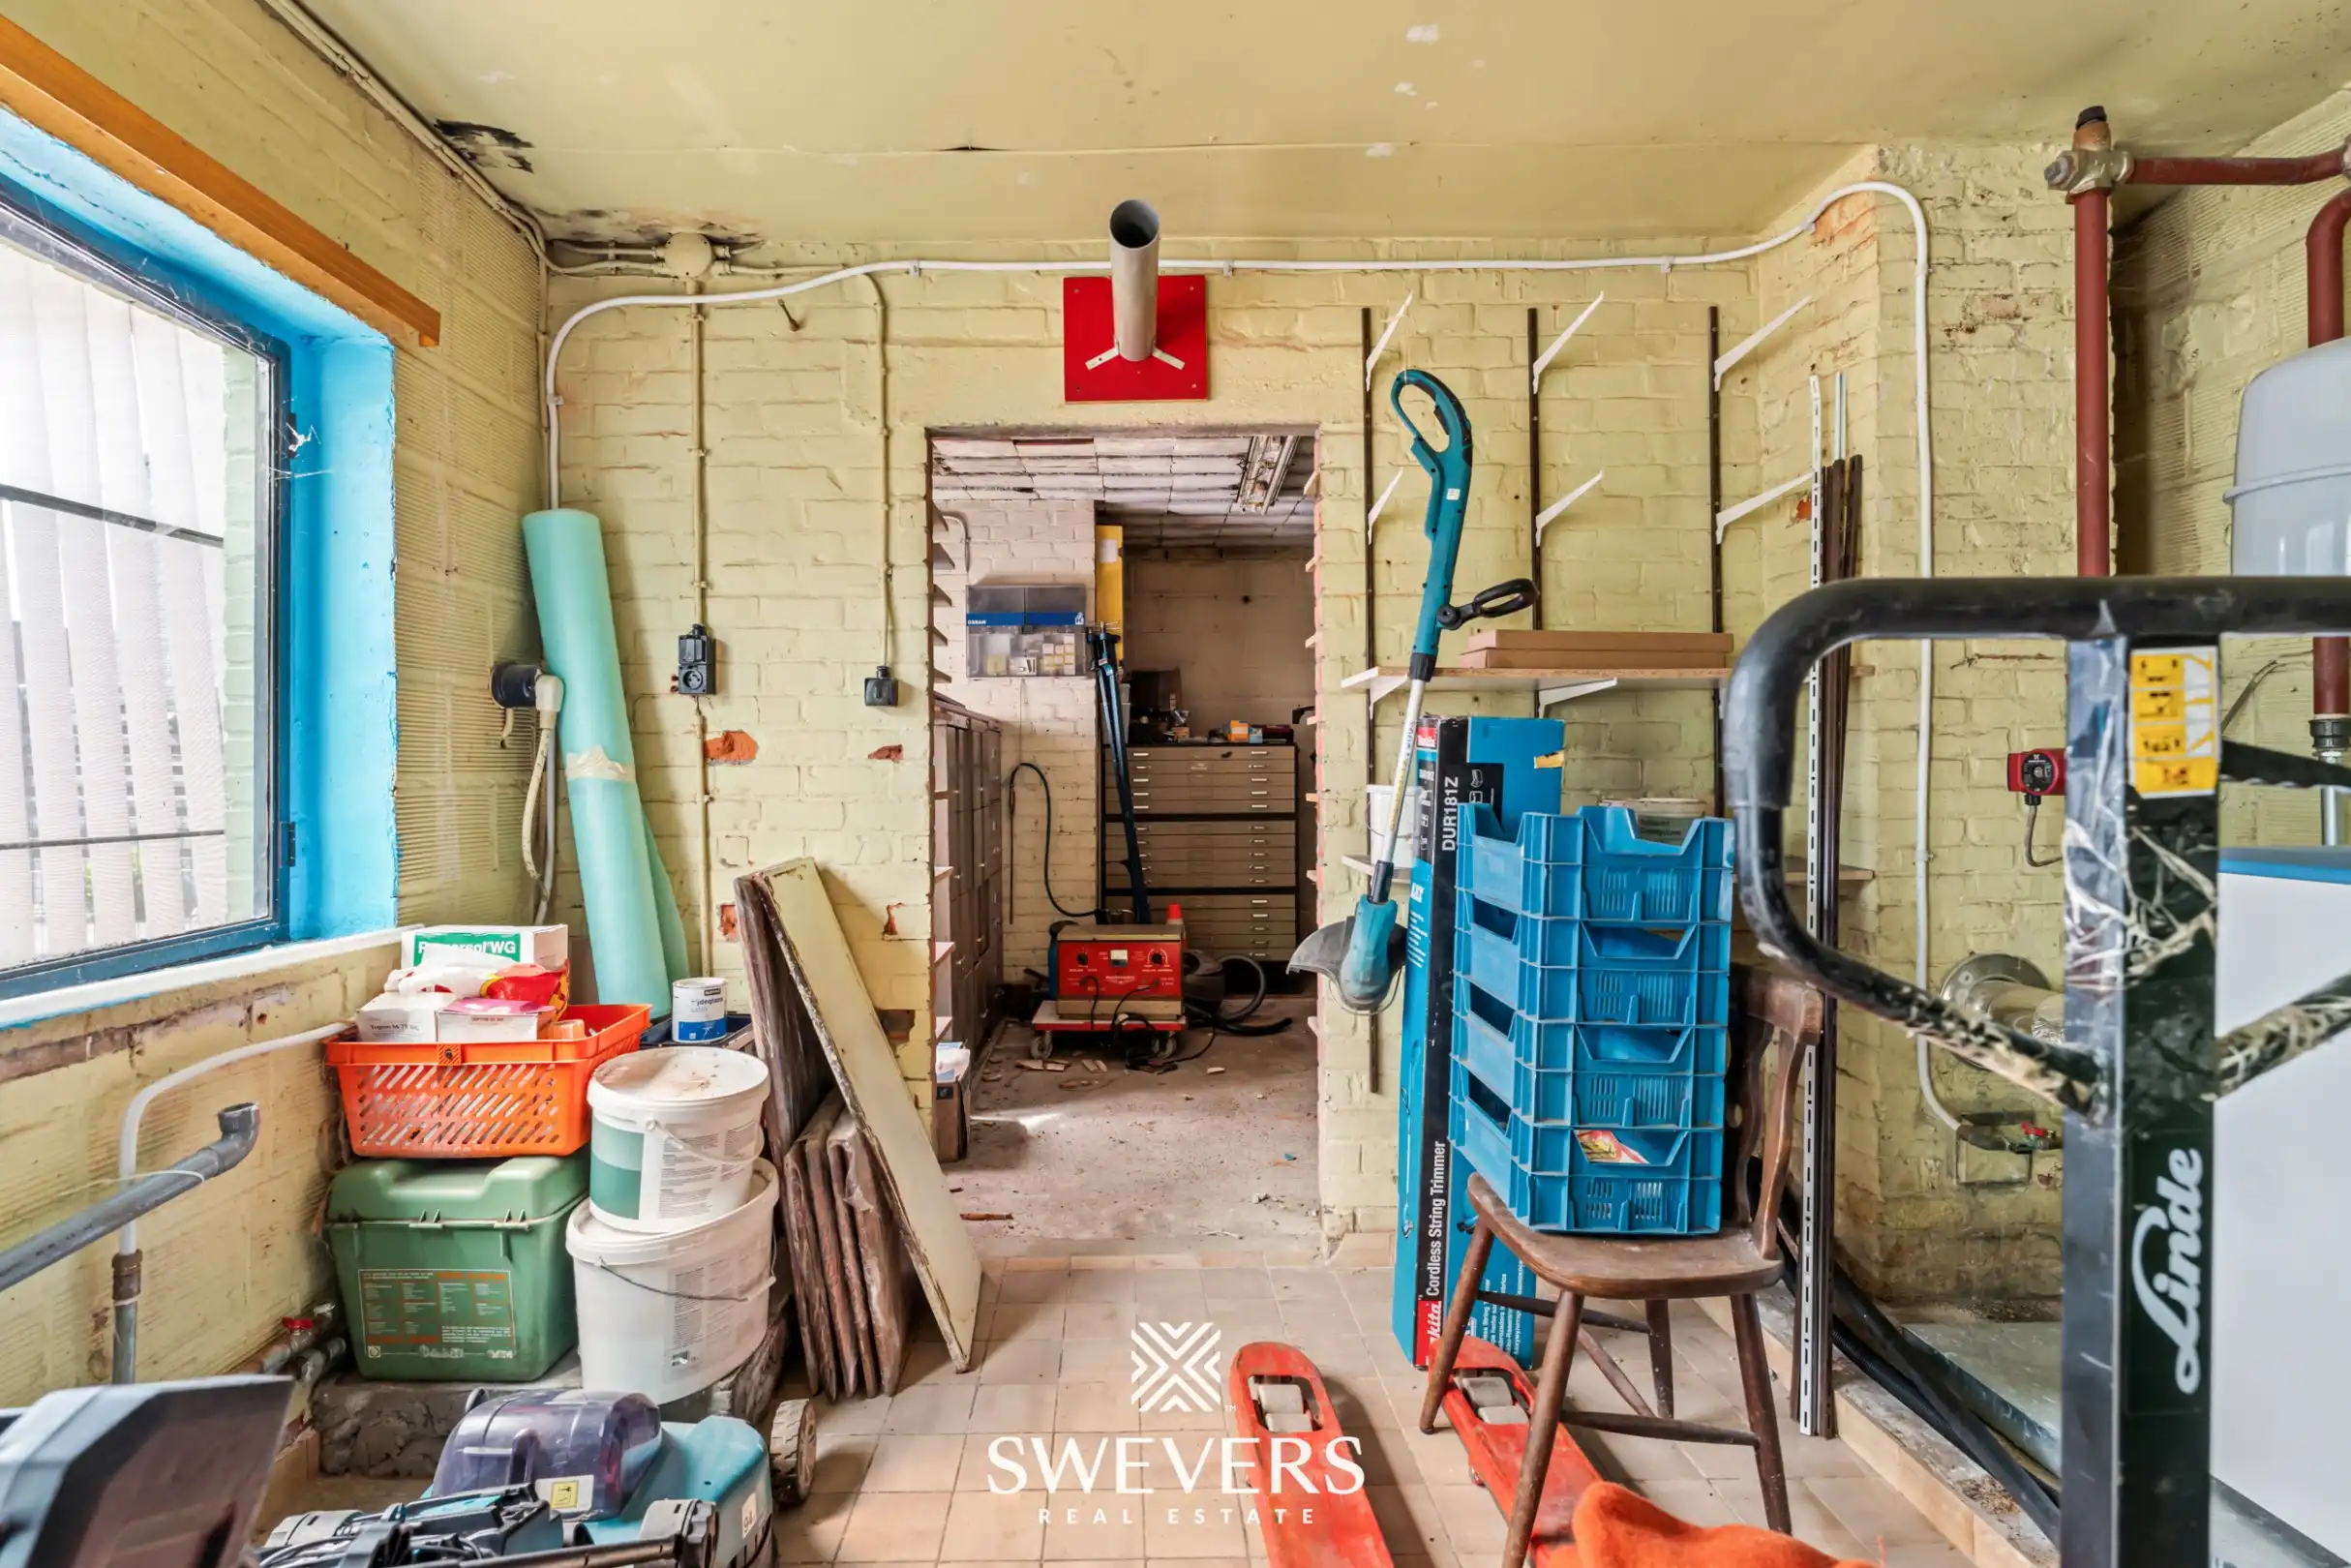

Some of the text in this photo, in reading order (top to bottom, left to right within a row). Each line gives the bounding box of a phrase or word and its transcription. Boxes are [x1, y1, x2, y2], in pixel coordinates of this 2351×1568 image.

[1442, 776, 1460, 852] DUR181Z
[490, 940, 516, 954] WG
[1430, 1140, 1447, 1196] Trimmer
[1429, 1199, 1446, 1237] String
[1426, 1235, 1442, 1298] Cordless
[2132, 1148, 2203, 1395] Linde
